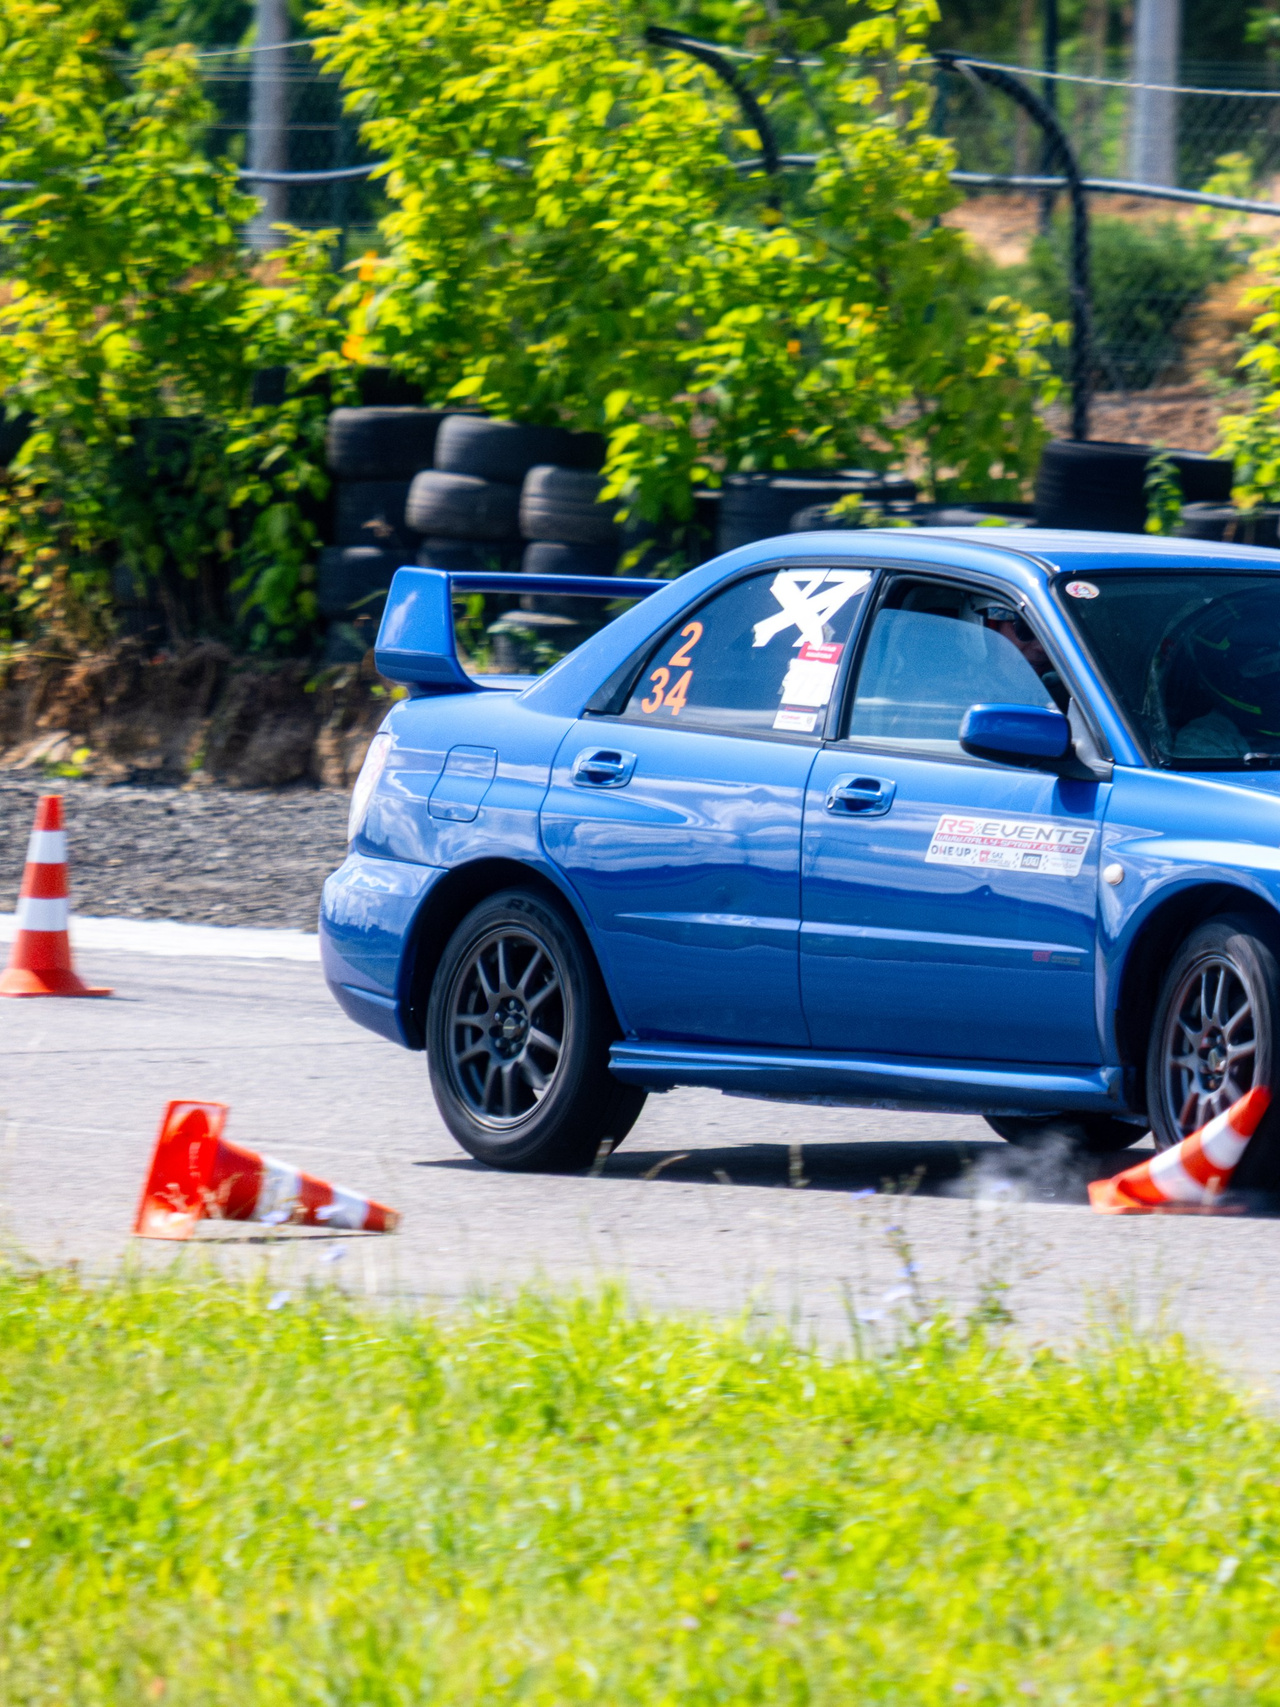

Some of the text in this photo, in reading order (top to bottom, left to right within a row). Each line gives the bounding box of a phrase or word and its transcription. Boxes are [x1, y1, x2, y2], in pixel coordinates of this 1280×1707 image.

[668, 622, 703, 667] 2
[641, 667, 693, 716] 34
[938, 818, 1090, 845] RS EVENTS
